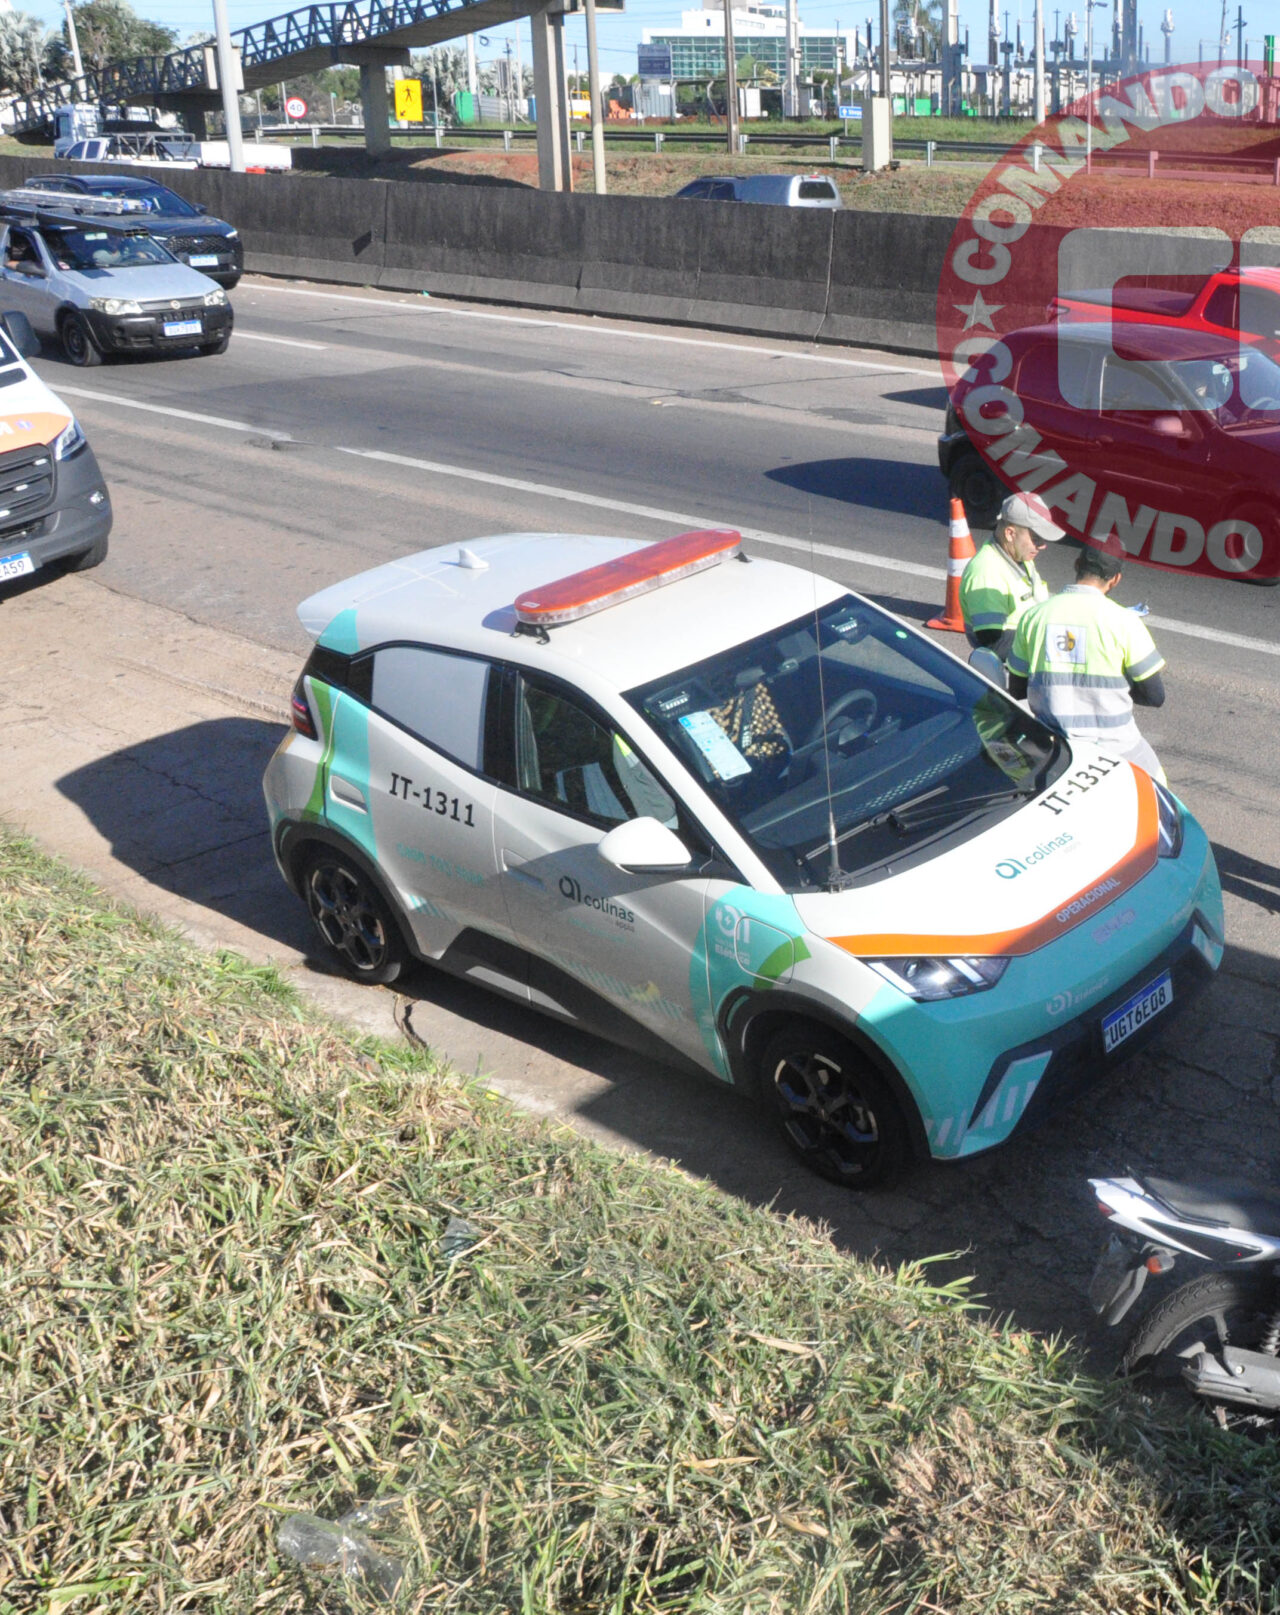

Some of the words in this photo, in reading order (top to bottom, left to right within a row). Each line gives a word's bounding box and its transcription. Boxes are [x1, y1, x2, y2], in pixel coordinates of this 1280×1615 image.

[289, 102, 303, 112] 40
[389, 772, 475, 828] IT-1311
[1038, 756, 1121, 816] IT-1311
[1025, 832, 1074, 865] colinas
[583, 894, 635, 923] colinas
[1055, 877, 1121, 923] OPERACIONAL
[1109, 985, 1167, 1045] UGT6E08
